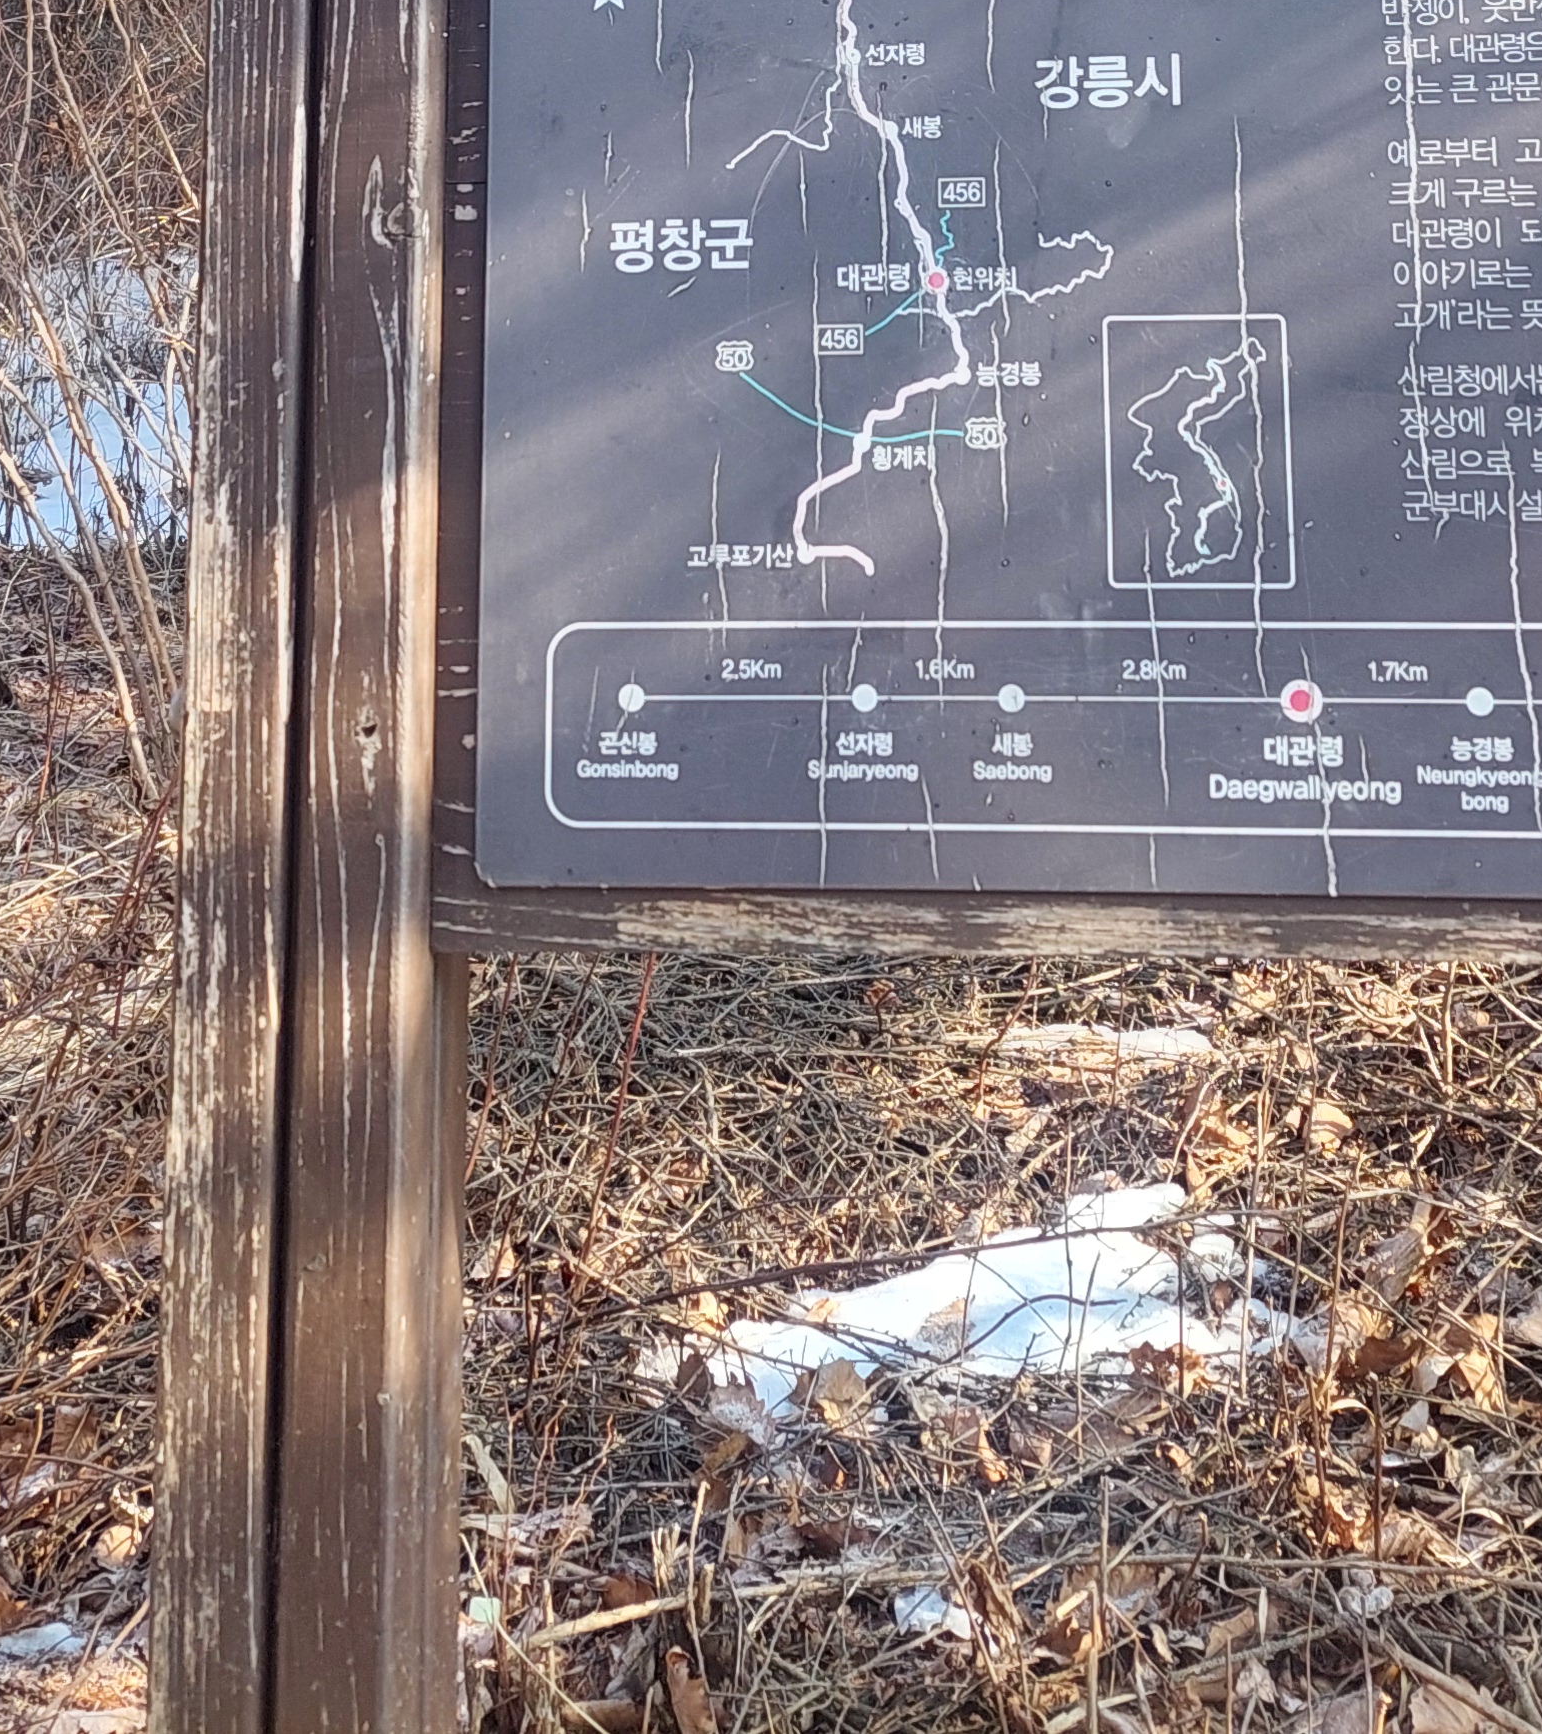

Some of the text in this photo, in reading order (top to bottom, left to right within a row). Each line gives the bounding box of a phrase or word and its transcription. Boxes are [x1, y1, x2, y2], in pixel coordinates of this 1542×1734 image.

[865, 43, 925, 66] 선자령
[1384, 35, 1442, 65] 한다.
[1035, 52, 1183, 110] 강릉시
[902, 116, 942, 139] 새봉
[1387, 136, 1497, 167] 예로부터
[943, 183, 981, 202] 456
[608, 217, 755, 272] 평창군
[837, 263, 910, 292] 대관령
[953, 266, 1017, 291] 현위치
[821, 329, 858, 349] 456
[722, 351, 747, 367] 50
[1399, 406, 1486, 439] 정상에
[971, 428, 998, 445] 50
[872, 445, 935, 471] 횡계치
[687, 543, 794, 569] 고루포기산
[722, 658, 782, 680] 2.5Km
[915, 658, 975, 680] 1.6Km
[1122, 660, 1187, 682] 2.8Km
[1368, 661, 1428, 683] 1.7Km
[598, 731, 657, 756] 곤신봉
[835, 731, 893, 757] 선자령
[992, 732, 1033, 757] 새봉
[1263, 736, 1344, 768] 대관령
[1451, 737, 1514, 762] 능경봉
[577, 759, 679, 782] Gonsinbong
[807, 759, 918, 783] Sunjaryeong
[973, 760, 1053, 783] Saebong
[1209, 773, 1402, 805] Daegwallyeong
[1461, 791, 1509, 814] bong
